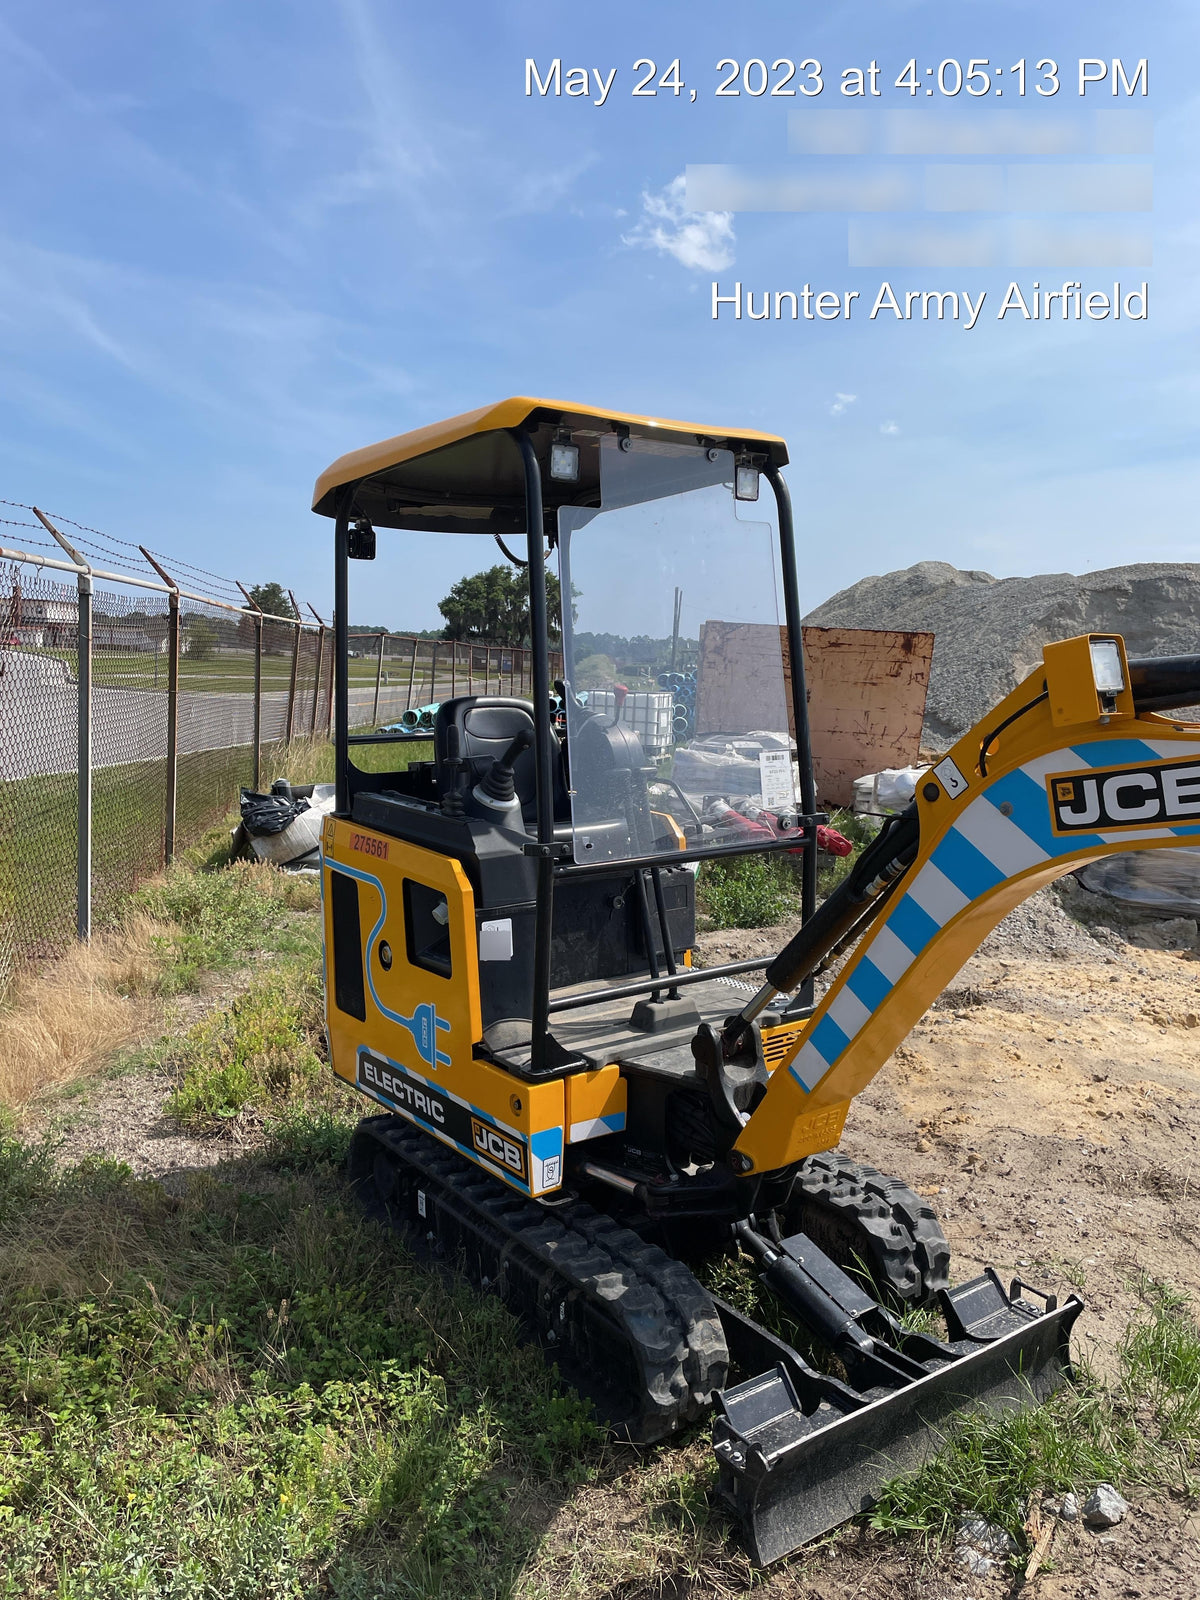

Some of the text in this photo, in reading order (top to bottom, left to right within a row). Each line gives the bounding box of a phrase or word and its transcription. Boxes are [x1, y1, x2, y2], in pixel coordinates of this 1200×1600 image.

[353, 834, 388, 860] 275561
[363, 1060, 446, 1125] ELECTRIC
[474, 1129, 522, 1172] JCB
